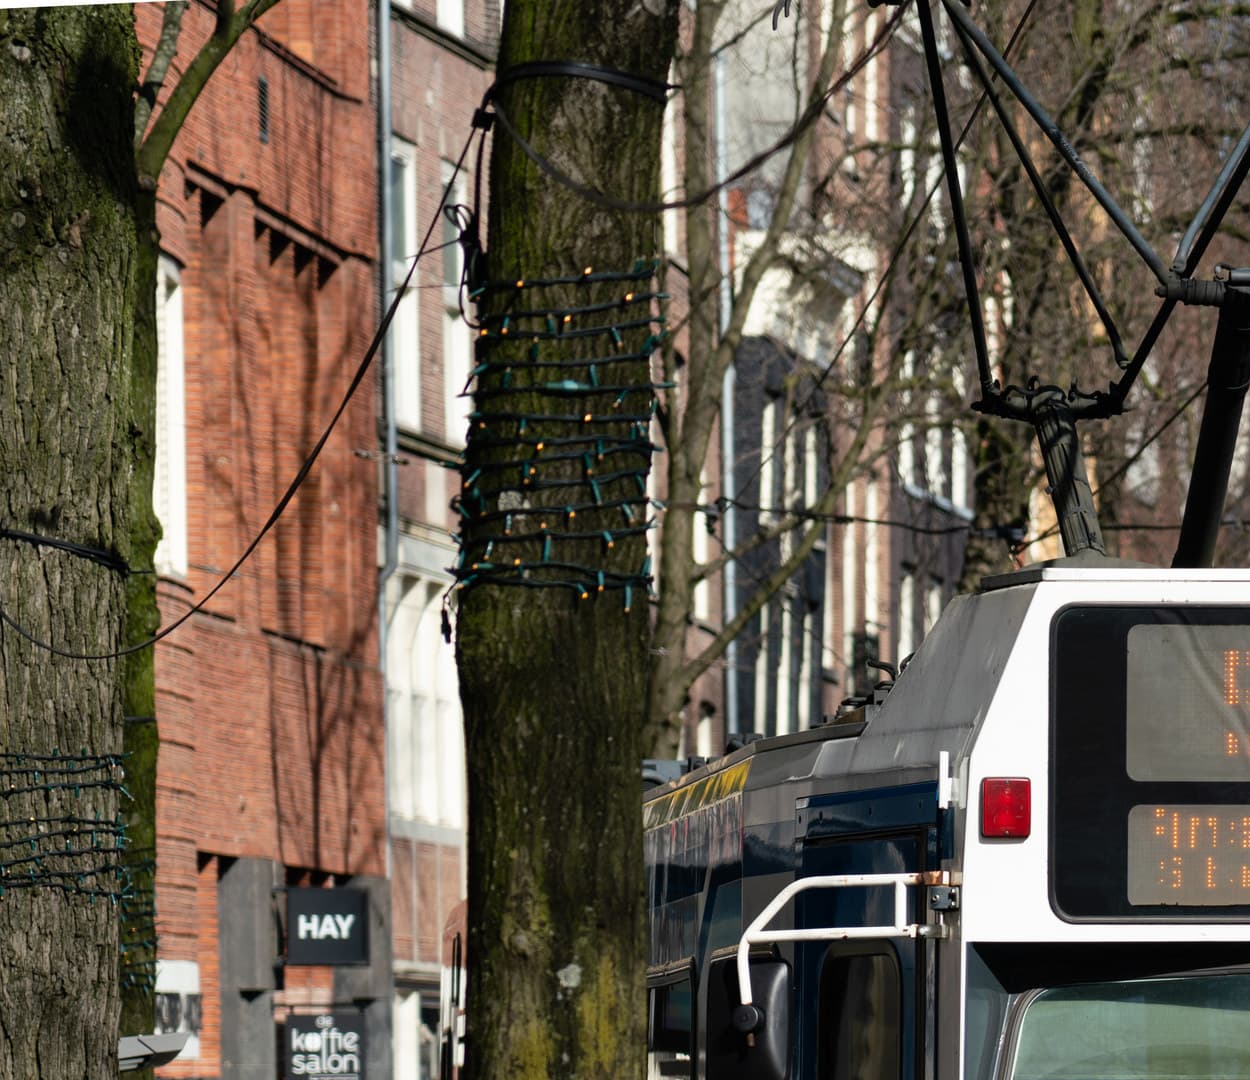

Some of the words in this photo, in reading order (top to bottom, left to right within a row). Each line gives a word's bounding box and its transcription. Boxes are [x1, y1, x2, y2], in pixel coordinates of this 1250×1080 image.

[298, 914, 354, 939] HAY
[291, 1027, 359, 1053] koffie
[292, 1053, 359, 1075] salon
